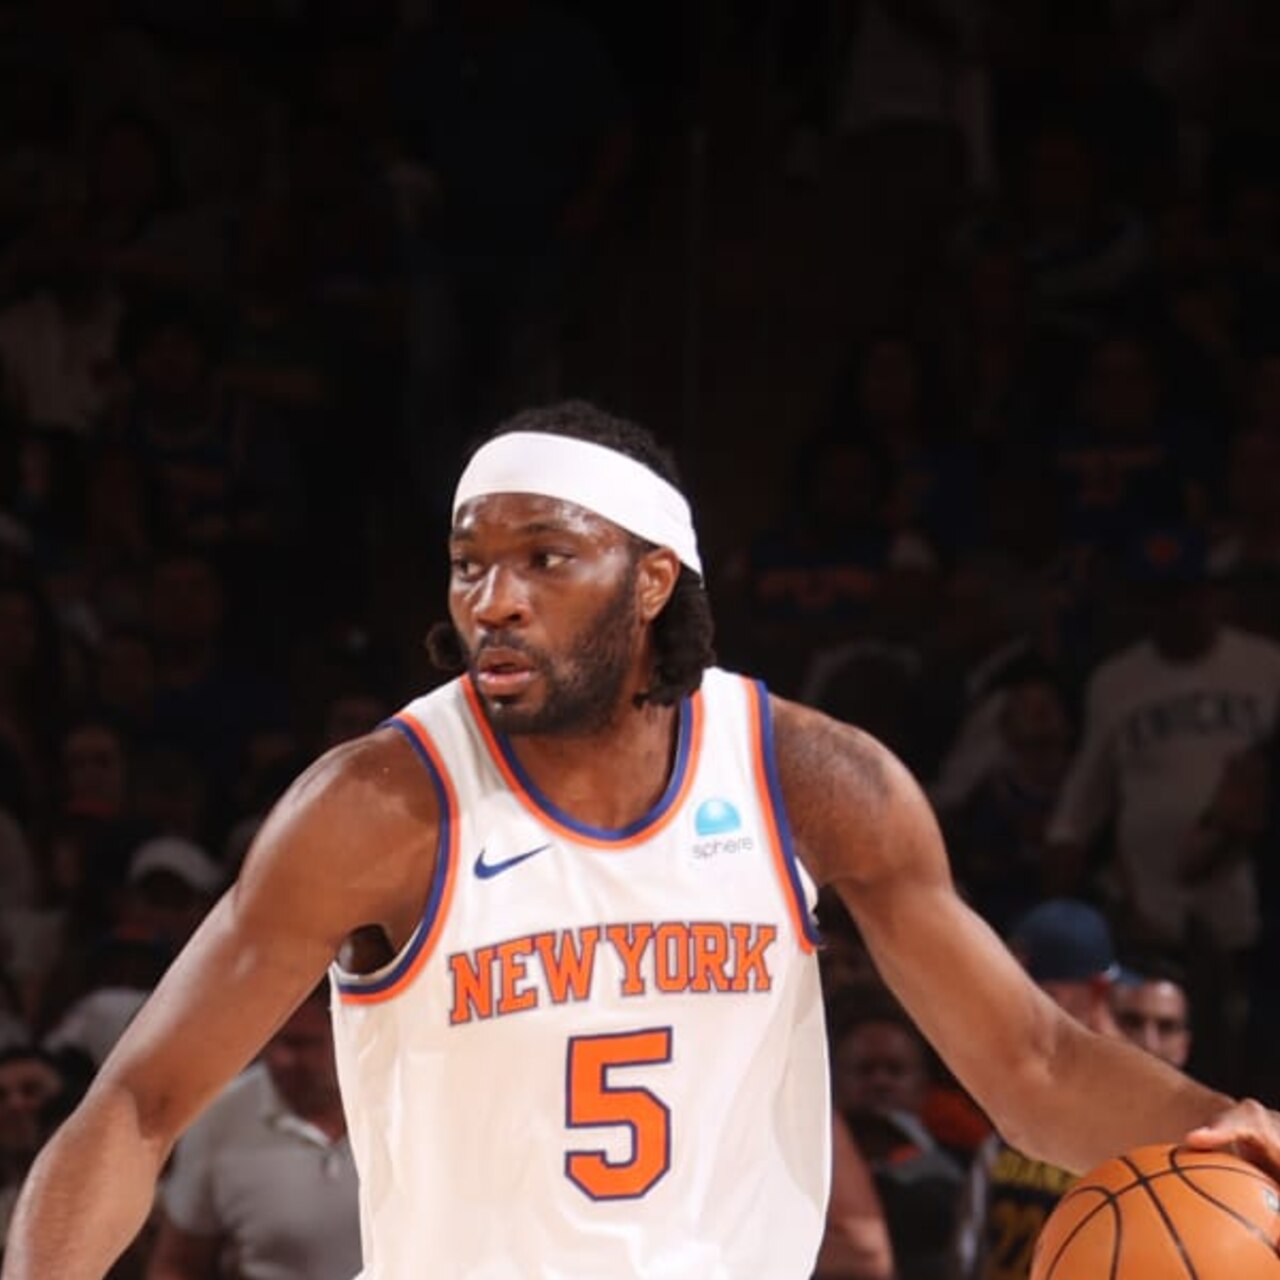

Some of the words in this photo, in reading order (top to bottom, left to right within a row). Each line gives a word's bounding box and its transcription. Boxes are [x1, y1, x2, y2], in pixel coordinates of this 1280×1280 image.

[692, 837, 754, 860] sphere
[447, 925, 601, 1025] NEW
[606, 922, 777, 996] YORK
[565, 1026, 673, 1203] 5
